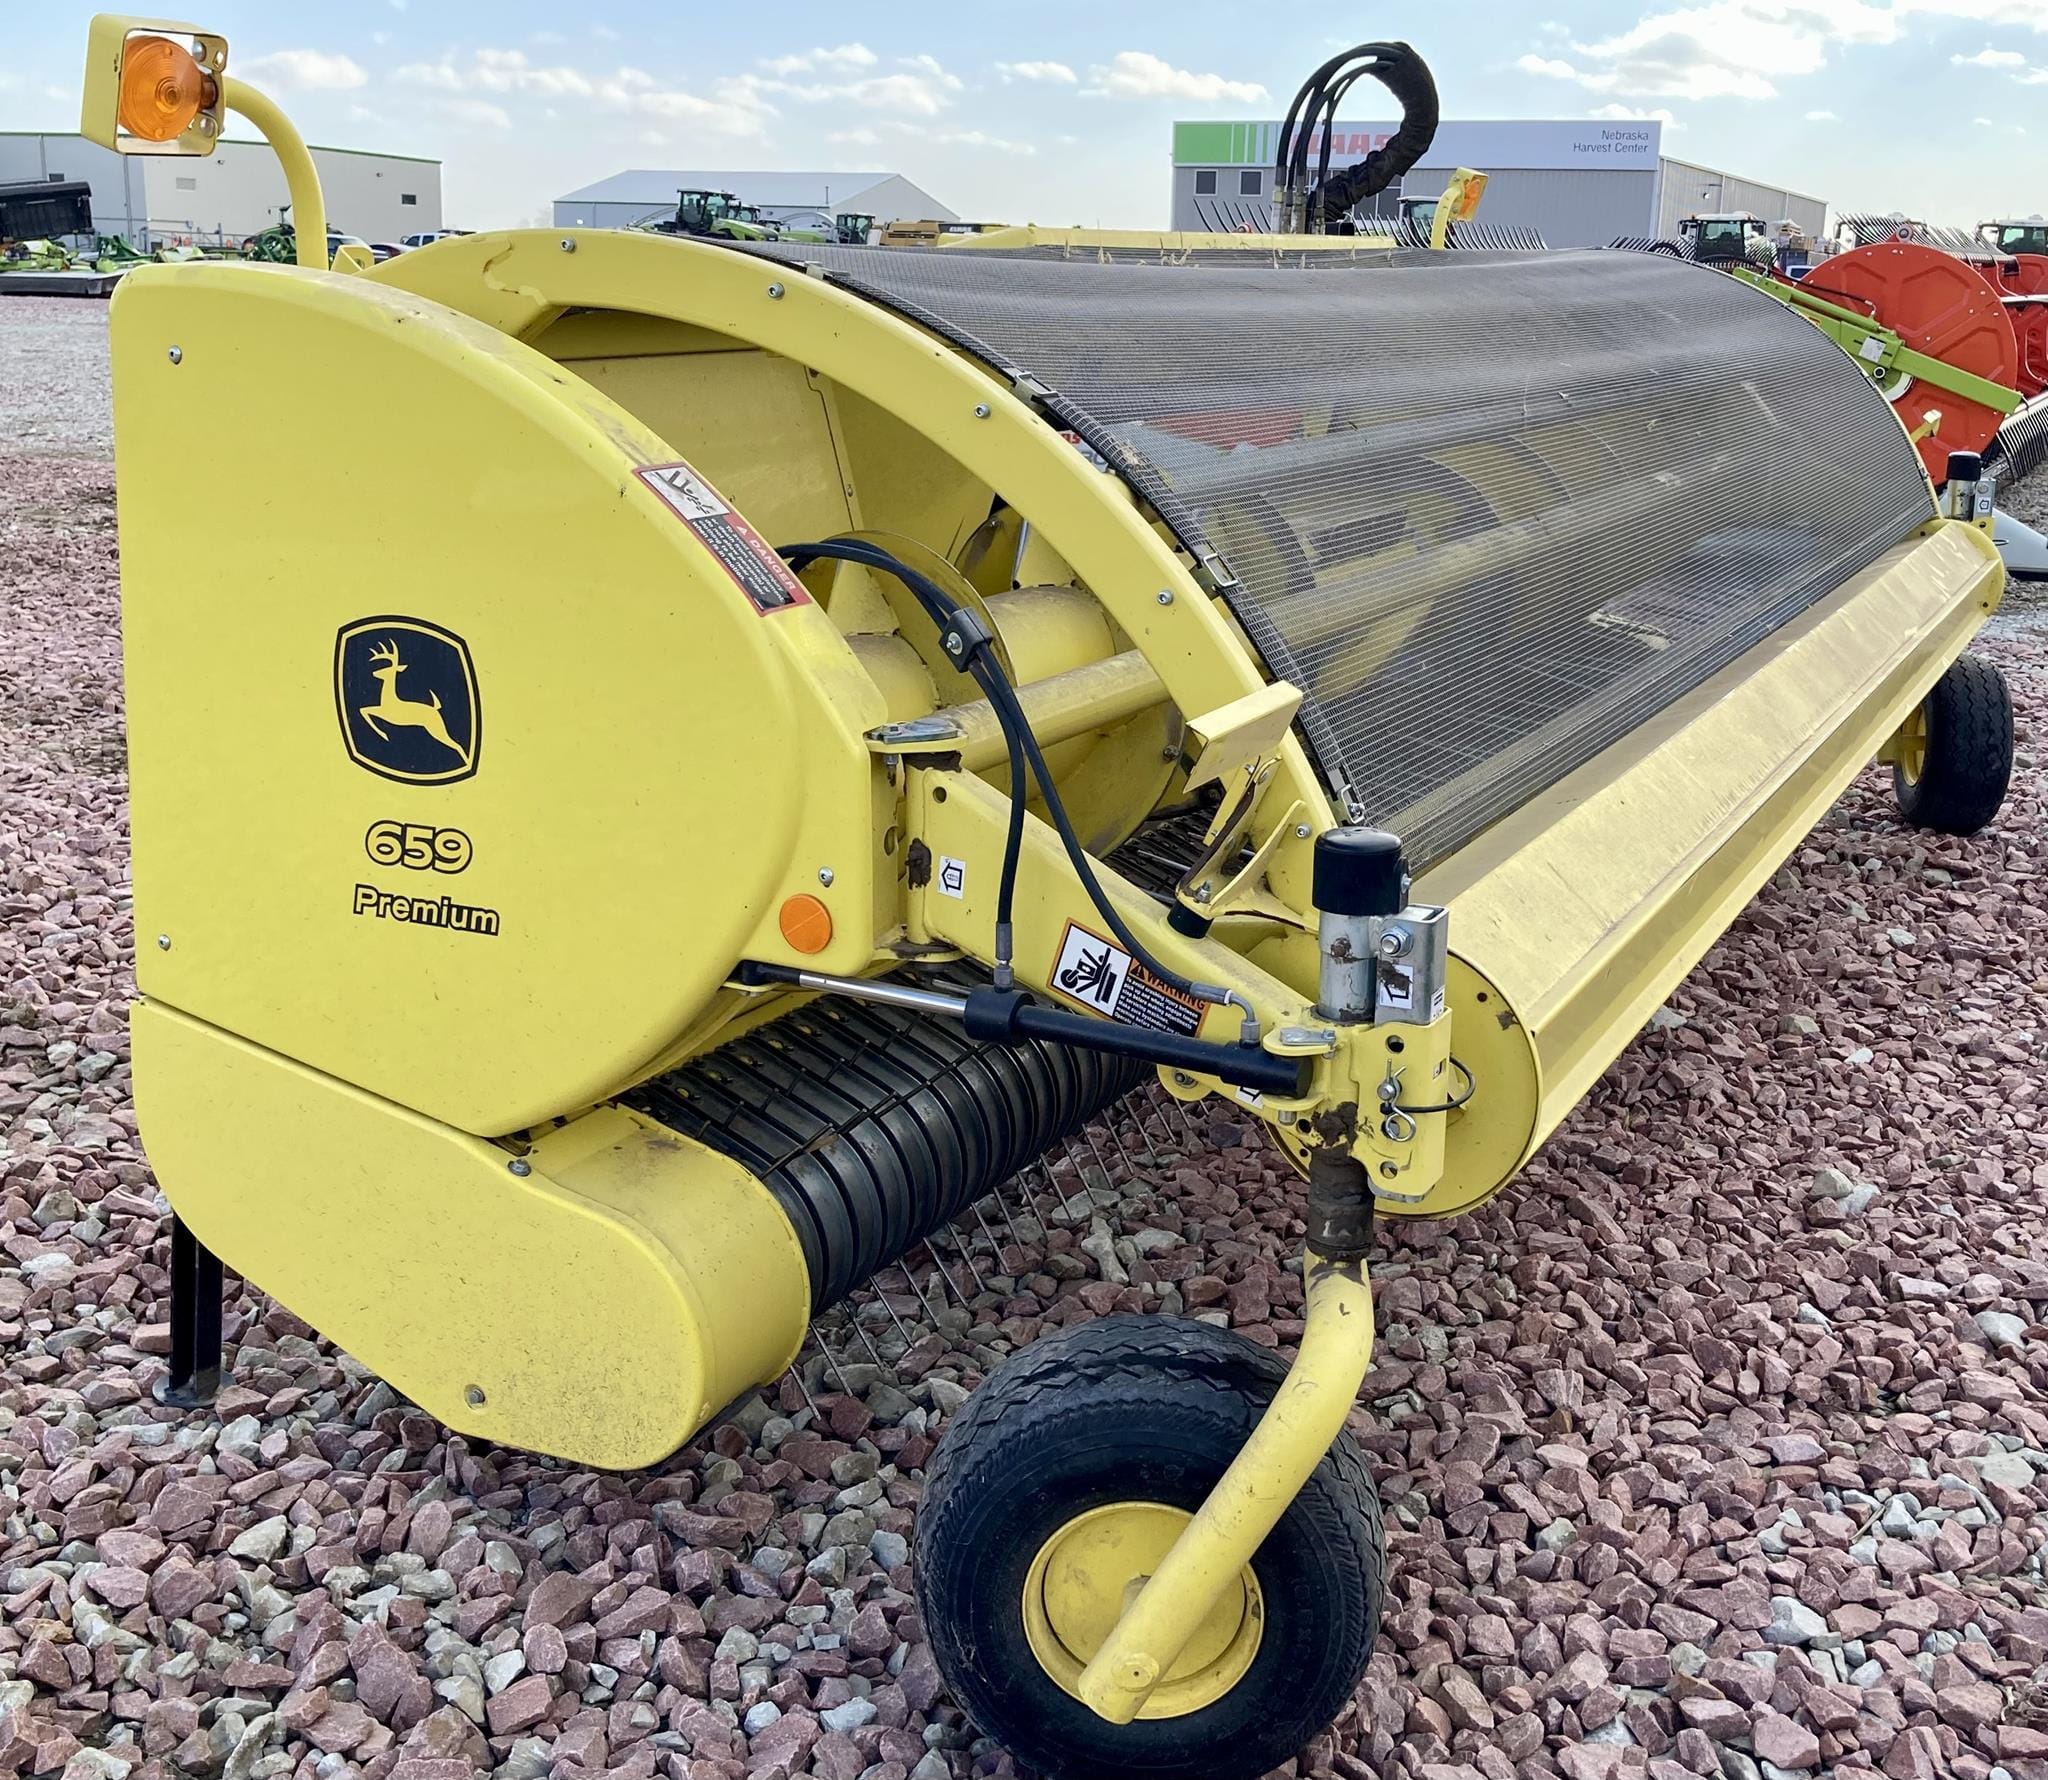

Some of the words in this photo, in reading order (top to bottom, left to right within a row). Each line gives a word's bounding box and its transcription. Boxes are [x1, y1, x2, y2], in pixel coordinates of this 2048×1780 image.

[1573, 142, 1612, 153] Harvest
[1614, 142, 1649, 153] Center
[1601, 129, 1649, 141] Nebraska
[691, 521, 708, 537] when
[713, 527, 723, 538] not
[722, 538, 738, 555] allow
[717, 525, 734, 542] death
[733, 543, 748, 558] from
[698, 520, 721, 544] clothing
[735, 561, 749, 576] near
[748, 577, 764, 594] auger
[732, 533, 748, 550] avoid
[767, 574, 784, 591] injury
[749, 539, 796, 589] DANGER
[365, 820, 473, 874] 659
[353, 883, 500, 936] Premium
